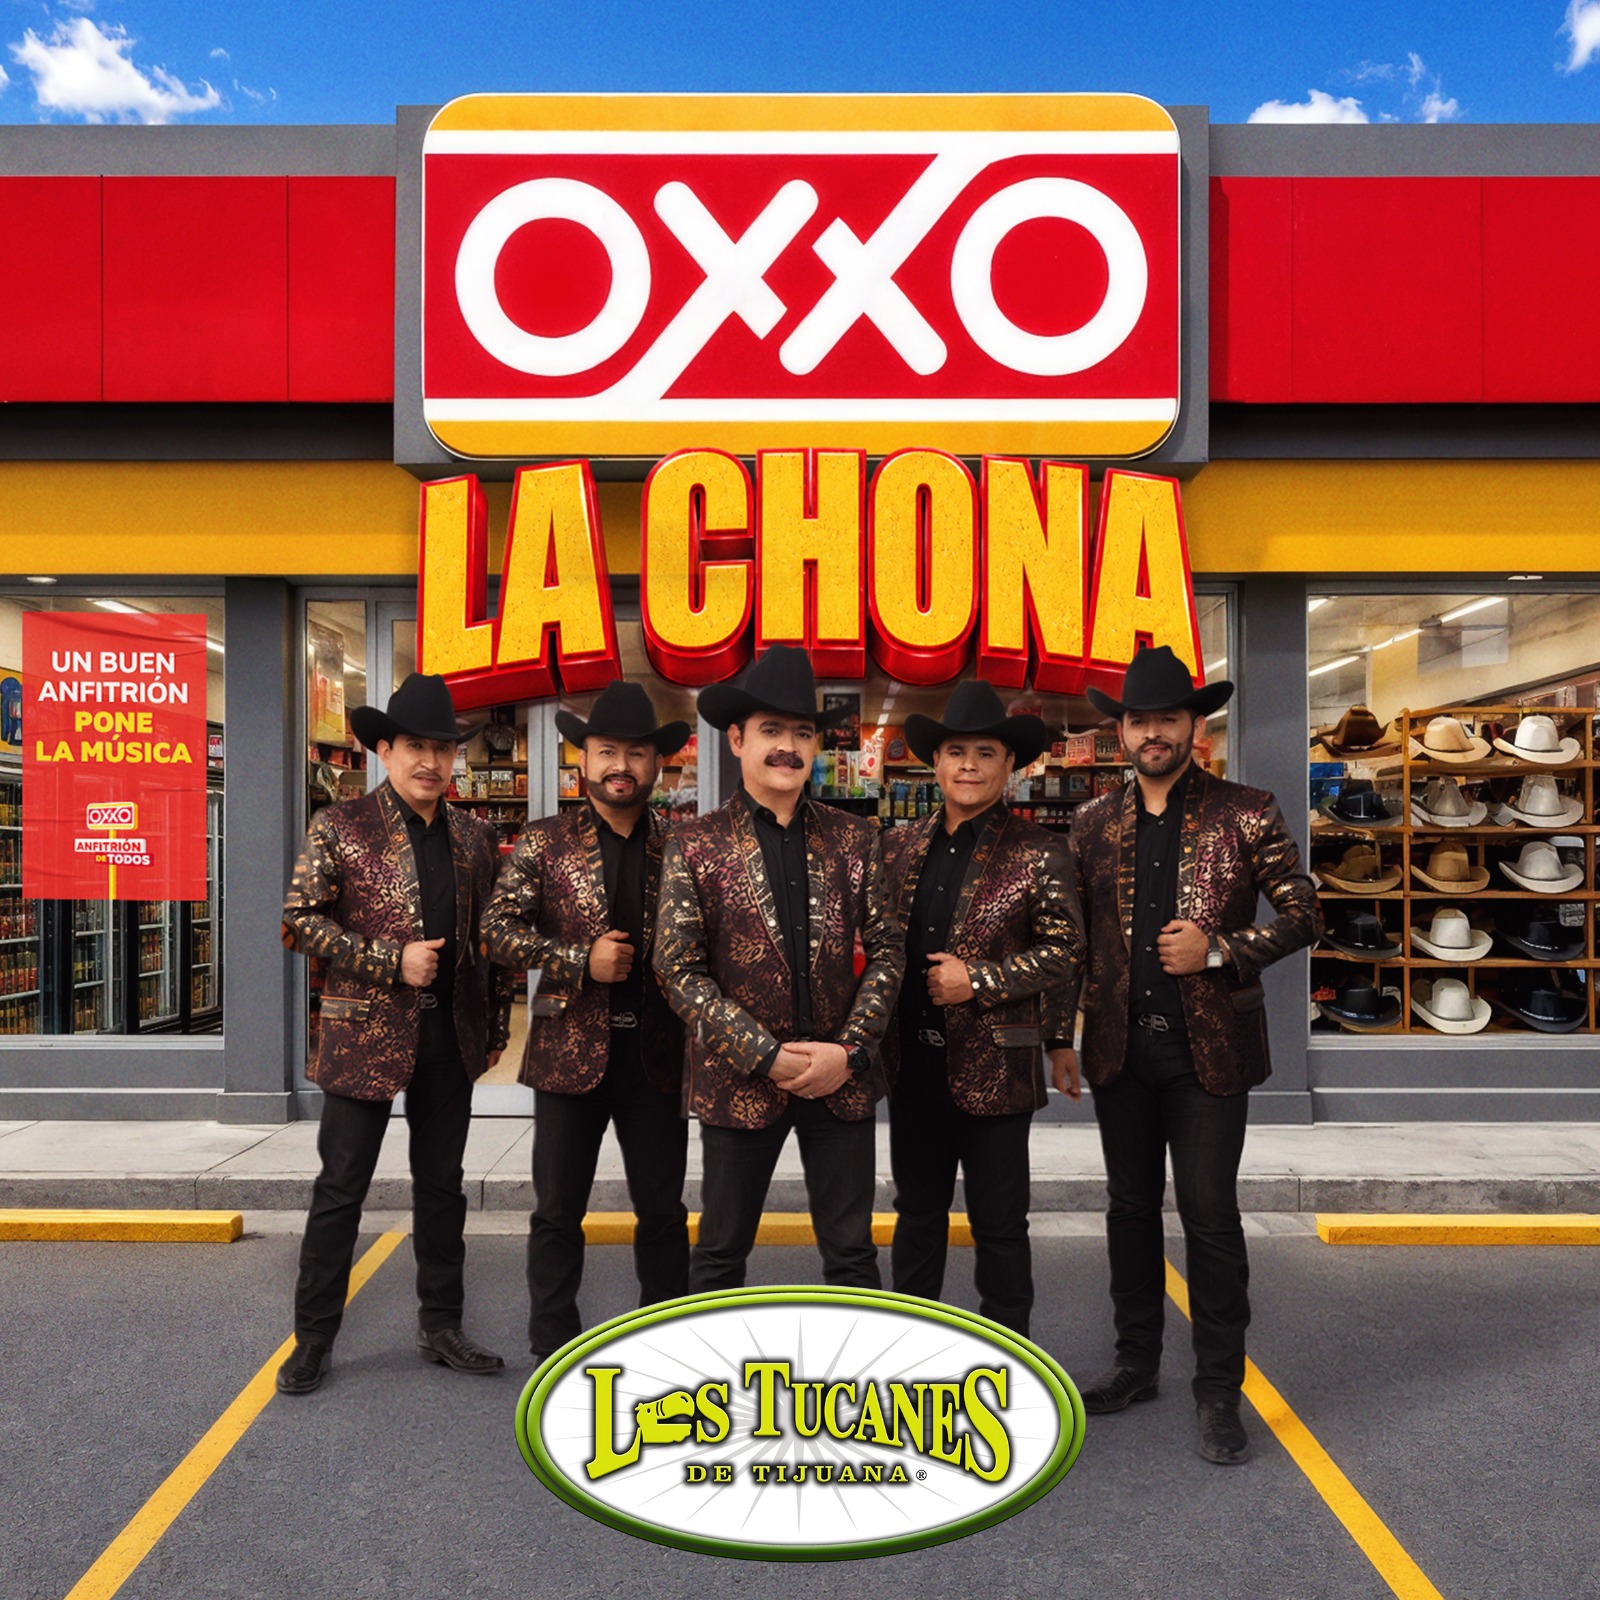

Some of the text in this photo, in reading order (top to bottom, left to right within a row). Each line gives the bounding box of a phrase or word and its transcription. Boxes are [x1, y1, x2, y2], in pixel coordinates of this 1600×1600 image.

[455, 165, 1148, 388] OXXO
[415, 447, 1204, 702] LA CHONA
[51, 651, 175, 674] UN BUEN
[38, 676, 188, 703] ANFITRIÓN
[75, 711, 153, 733] PONE
[36, 734, 192, 763] LA MÚSICA
[89, 807, 132, 825] OXXO
[76, 839, 141, 852] ANFITRIÓN
[95, 853, 151, 865] DE TODOS
